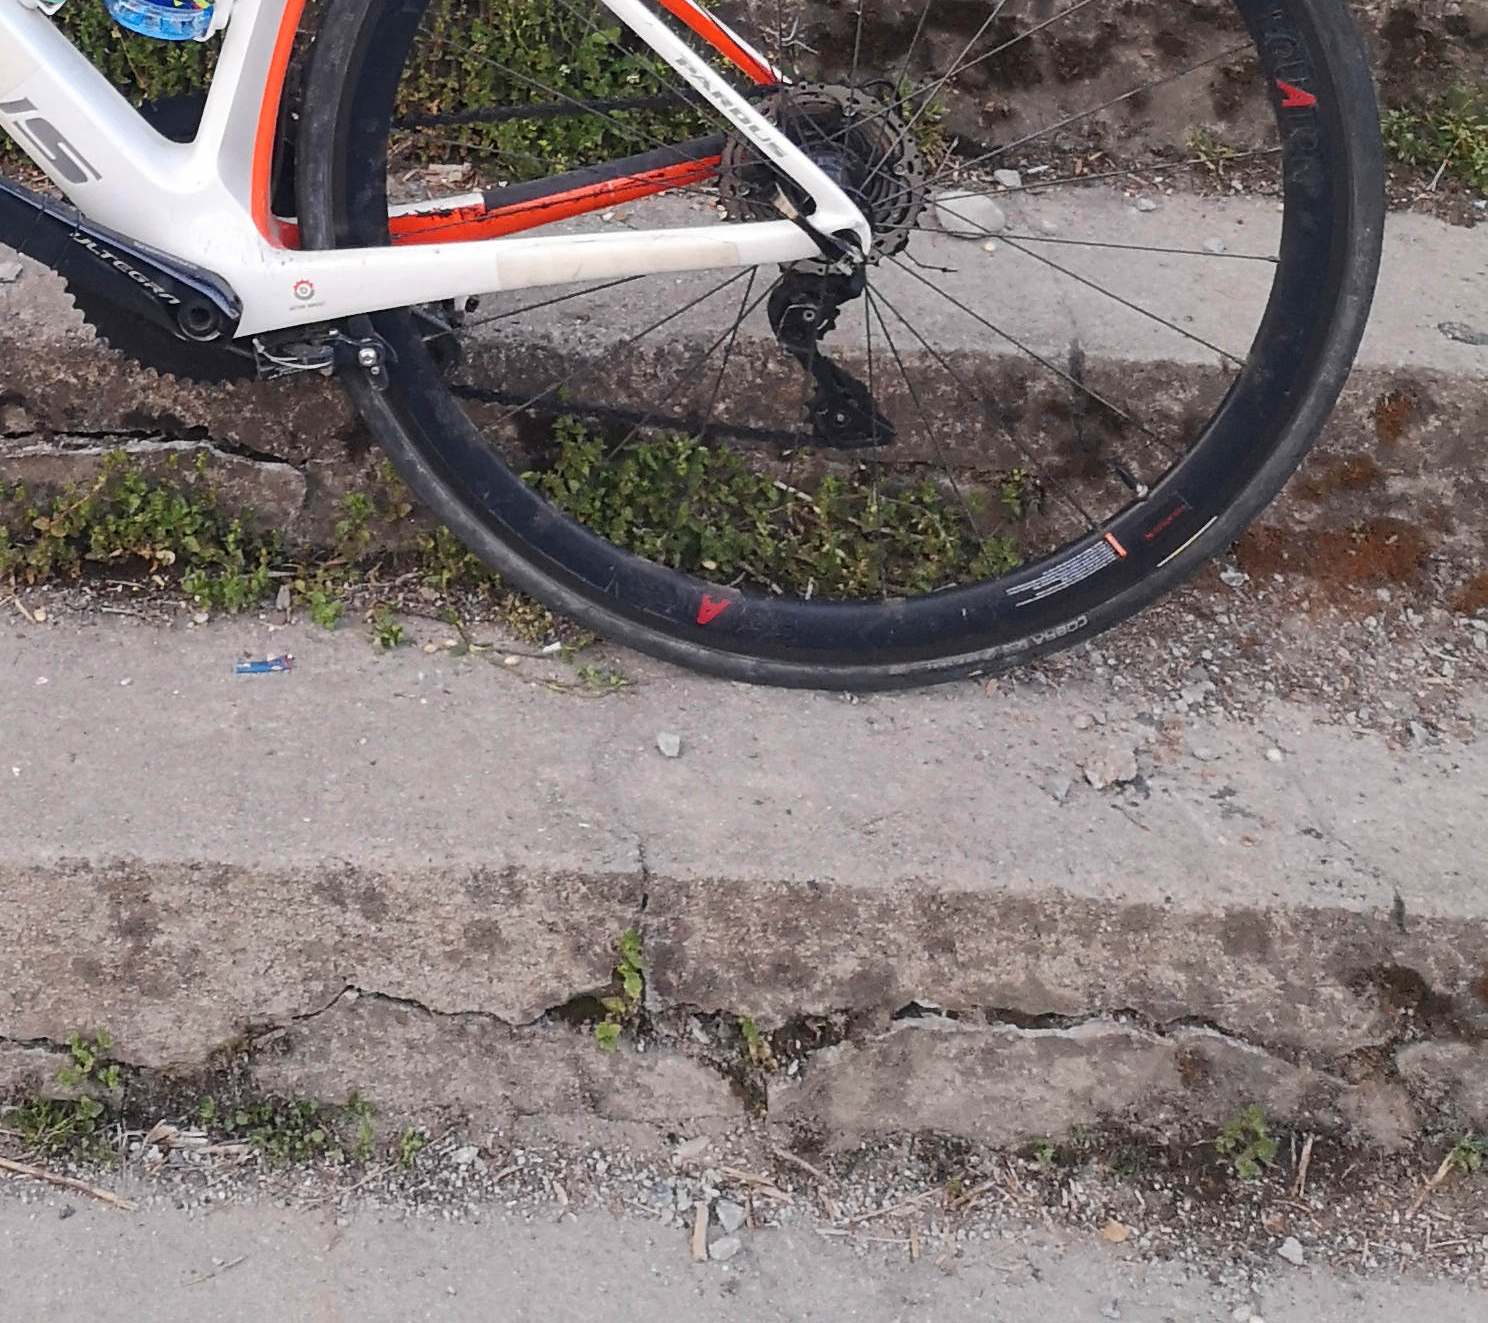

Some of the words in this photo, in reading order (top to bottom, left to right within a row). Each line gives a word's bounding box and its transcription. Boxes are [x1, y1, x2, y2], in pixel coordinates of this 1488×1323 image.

[674, 54, 786, 158] PARDUS
[68, 230, 181, 305] ULTEGRA
[1032, 614, 1089, 646] COBRA
